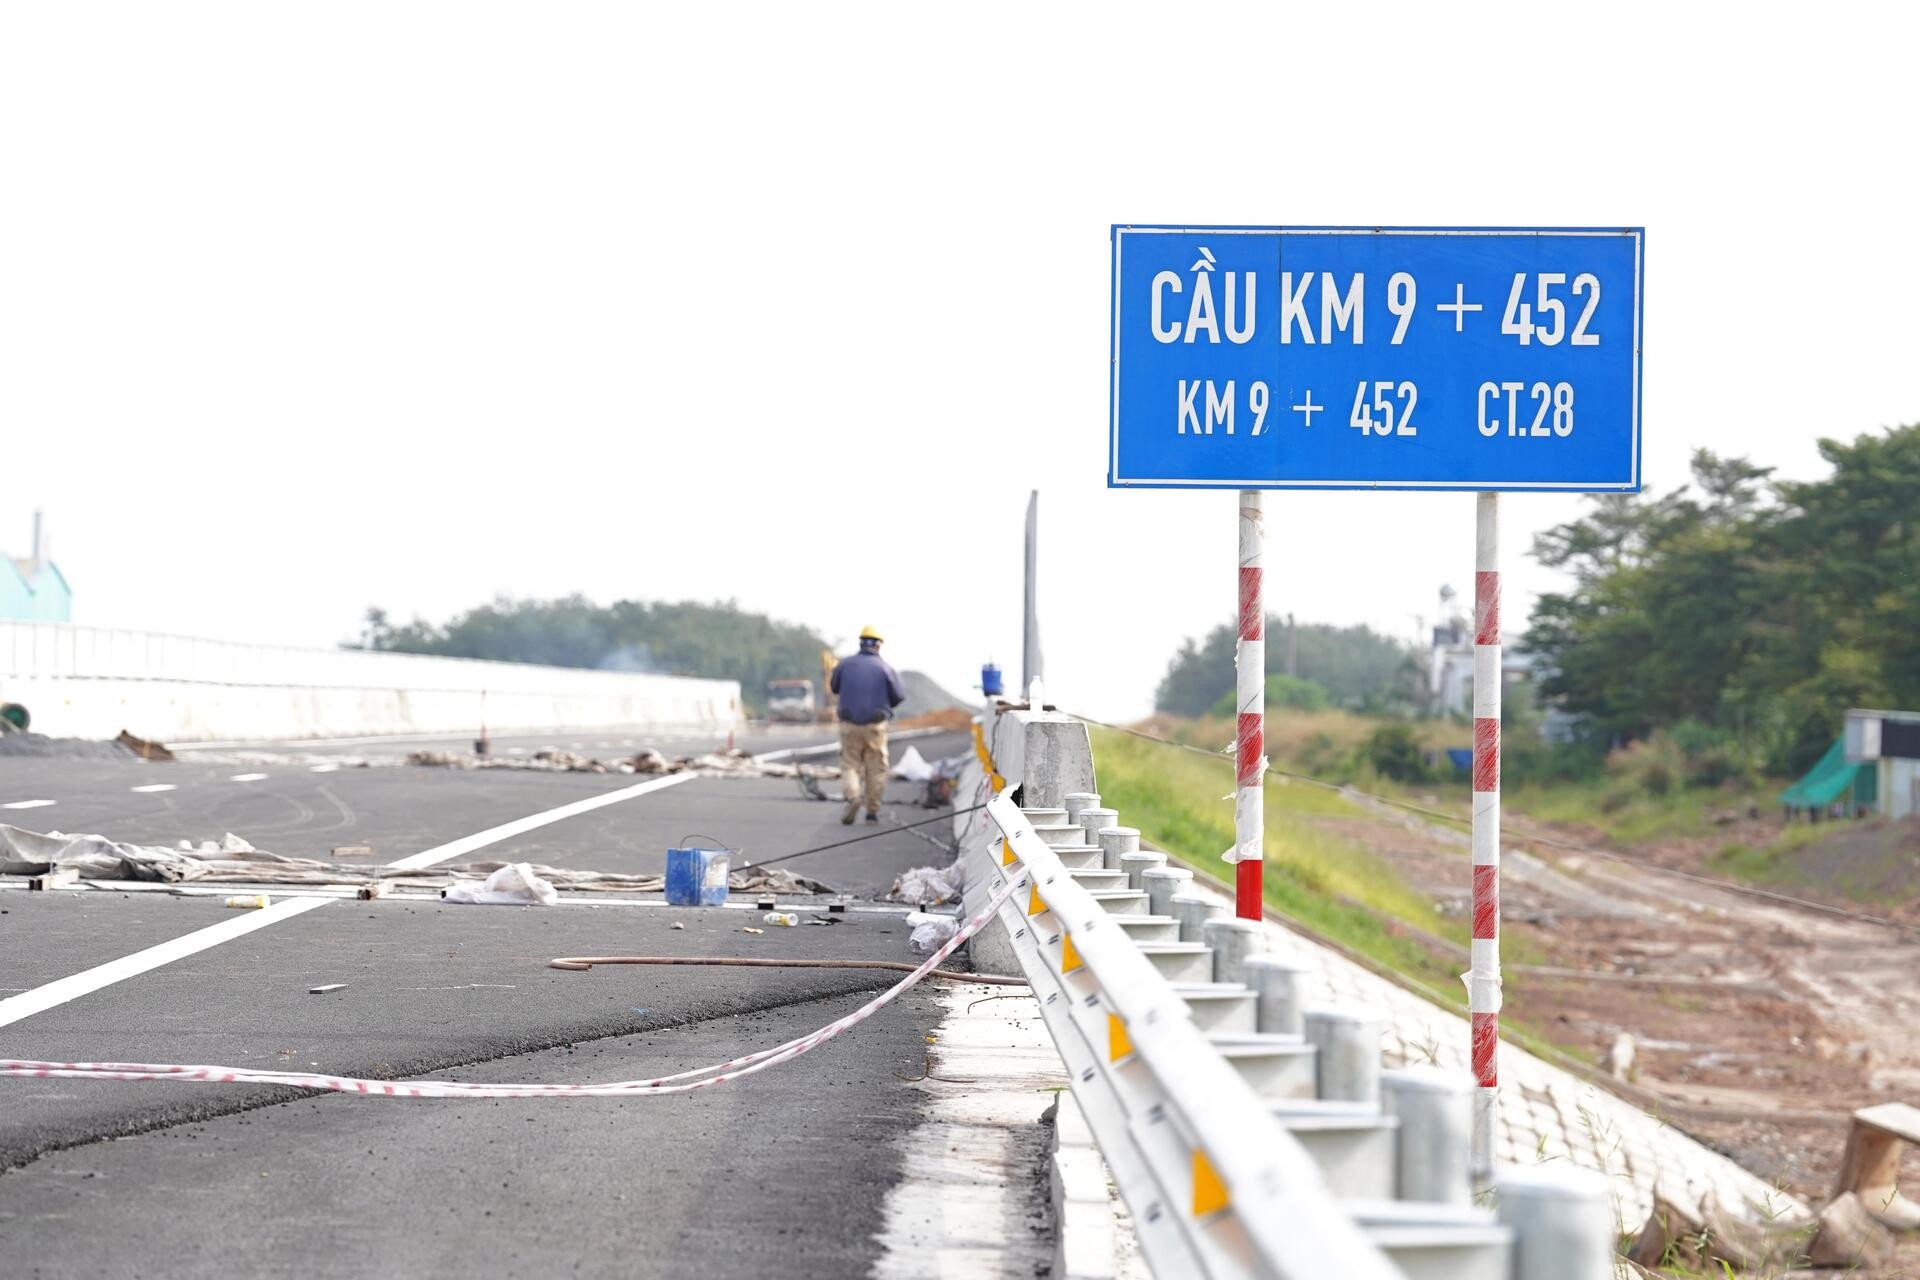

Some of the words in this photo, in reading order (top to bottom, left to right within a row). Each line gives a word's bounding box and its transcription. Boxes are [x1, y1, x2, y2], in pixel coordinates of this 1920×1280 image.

[1151, 247, 1256, 344] CẦU
[1280, 271, 1364, 345] KM
[1387, 272, 1417, 345] 9
[1436, 283, 1483, 332] +
[1501, 272, 1601, 346] 452
[1178, 379, 1235, 435] KM
[1249, 381, 1269, 436] 9
[1293, 390, 1324, 427] +
[1350, 381, 1418, 436] 452
[1478, 381, 1574, 437] CT.28
